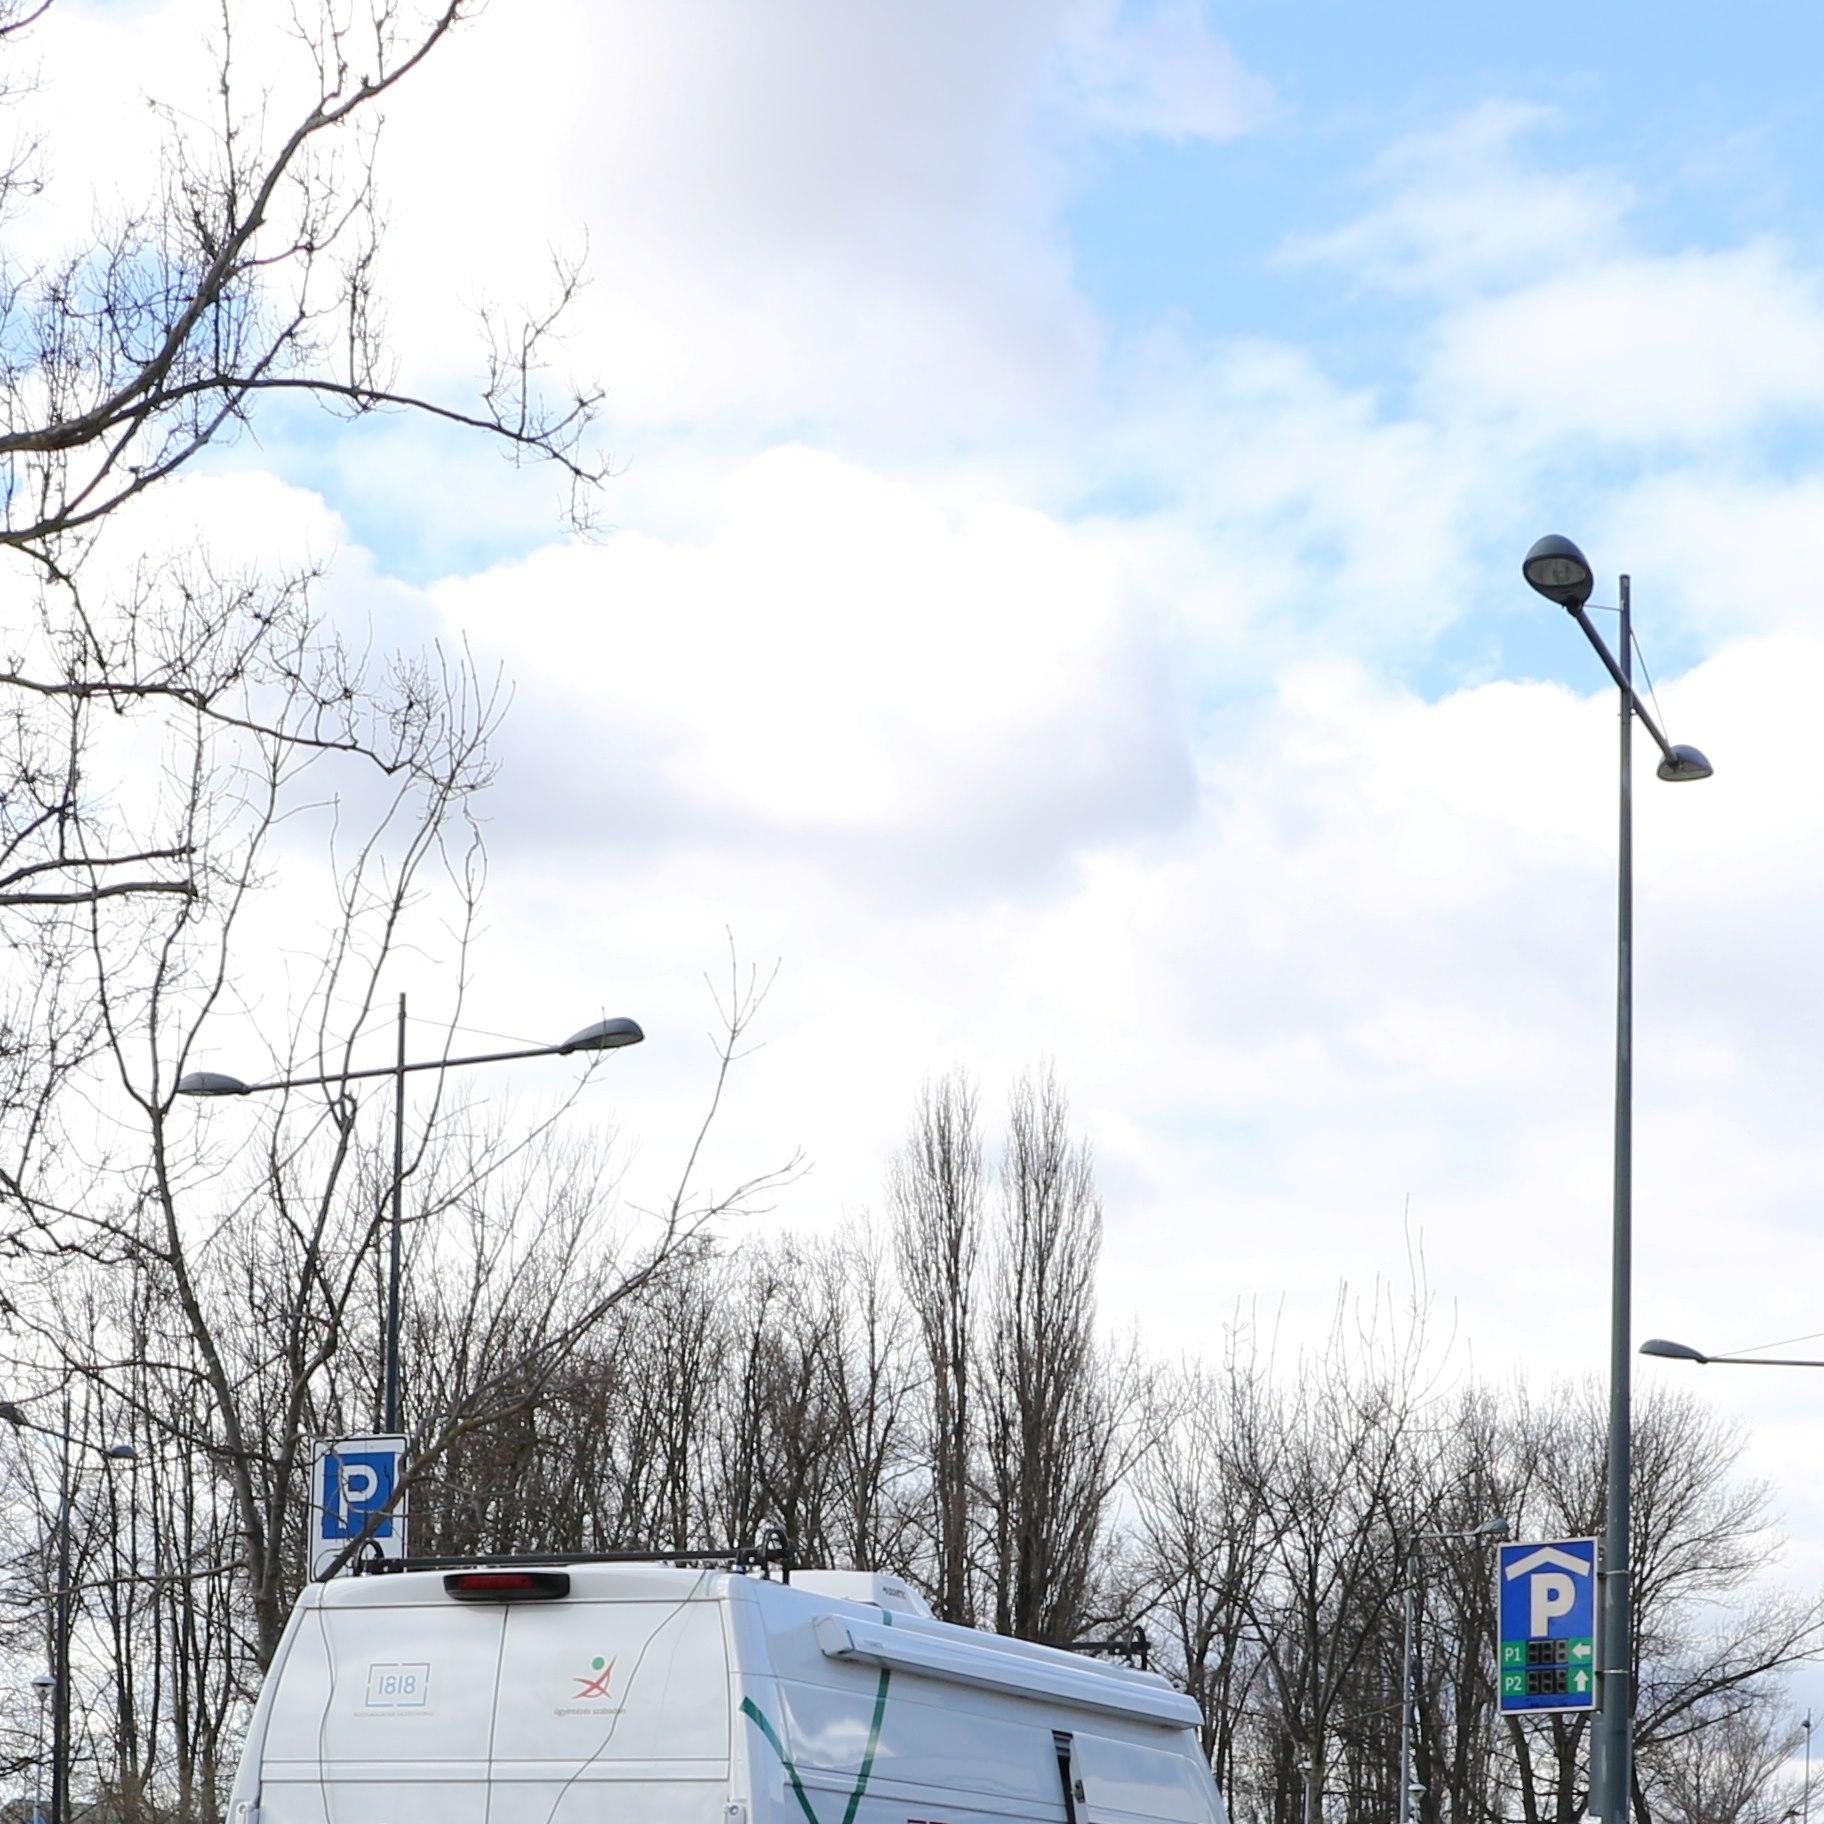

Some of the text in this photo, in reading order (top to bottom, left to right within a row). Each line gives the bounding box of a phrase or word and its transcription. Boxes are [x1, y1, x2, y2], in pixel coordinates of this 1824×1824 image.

[338, 1464, 378, 1529] P
[1530, 1572, 1576, 1638] P
[1504, 1647, 1522, 1663] P1
[378, 1676, 416, 1695] 1818
[1504, 1675, 1523, 1692] P2
